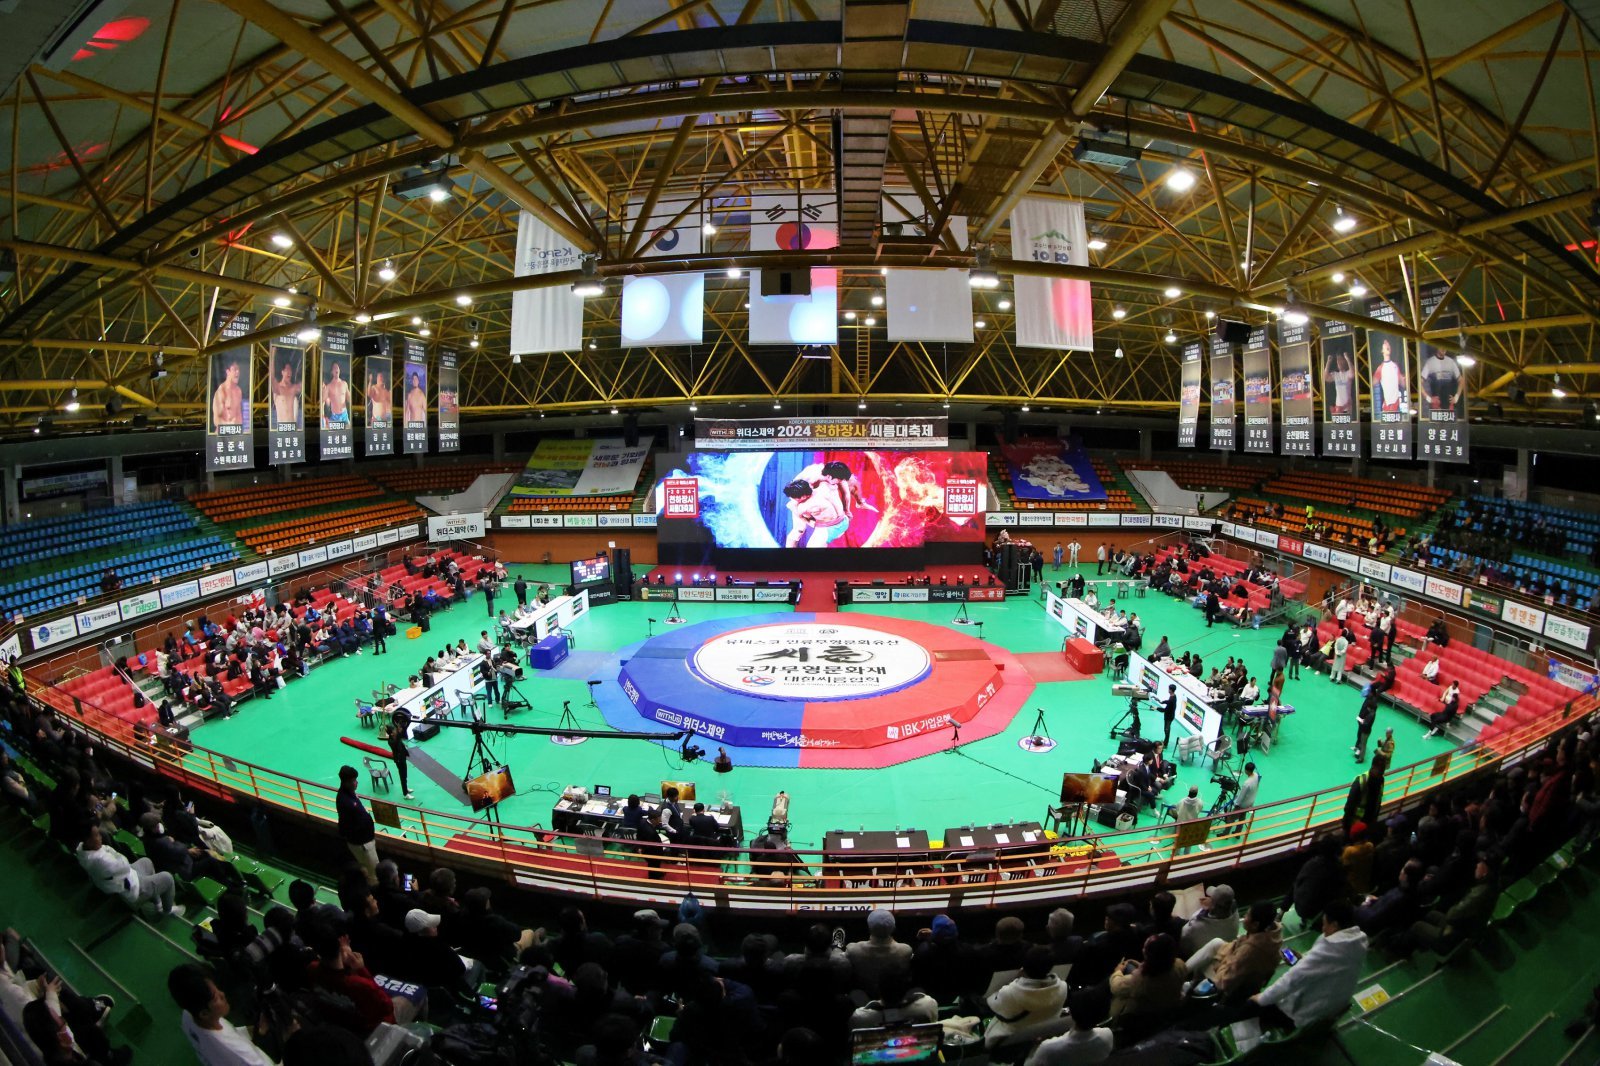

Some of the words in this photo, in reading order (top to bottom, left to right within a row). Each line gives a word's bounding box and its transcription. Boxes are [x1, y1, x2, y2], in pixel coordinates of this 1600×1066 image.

[219, 425, 242, 434] 태백장사
[278, 423, 296, 431] 금강장사
[736, 427, 774, 437] 위더스제약
[778, 426, 811, 437] 2024
[815, 424, 867, 438] 천하장사
[870, 424, 934, 438] 씨름대축제
[213, 455, 248, 465] 수원특례시청
[1004, 515, 1015, 523] 영암
[1155, 516, 1180, 525] 제일건설
[205, 575, 232, 591] 한도병원
[1430, 582, 1458, 599] 한도병원
[875, 592, 887, 602] 영암
[750, 645, 874, 663] 씨름
[736, 665, 888, 675] 국가무형문화재
[785, 676, 879, 684] 대한씨름협회
[657, 711, 681, 724] WITHUS
[683, 716, 726, 739] 위더스제약
[901, 723, 921, 737] IBK
[920, 713, 953, 730] 기업은행
